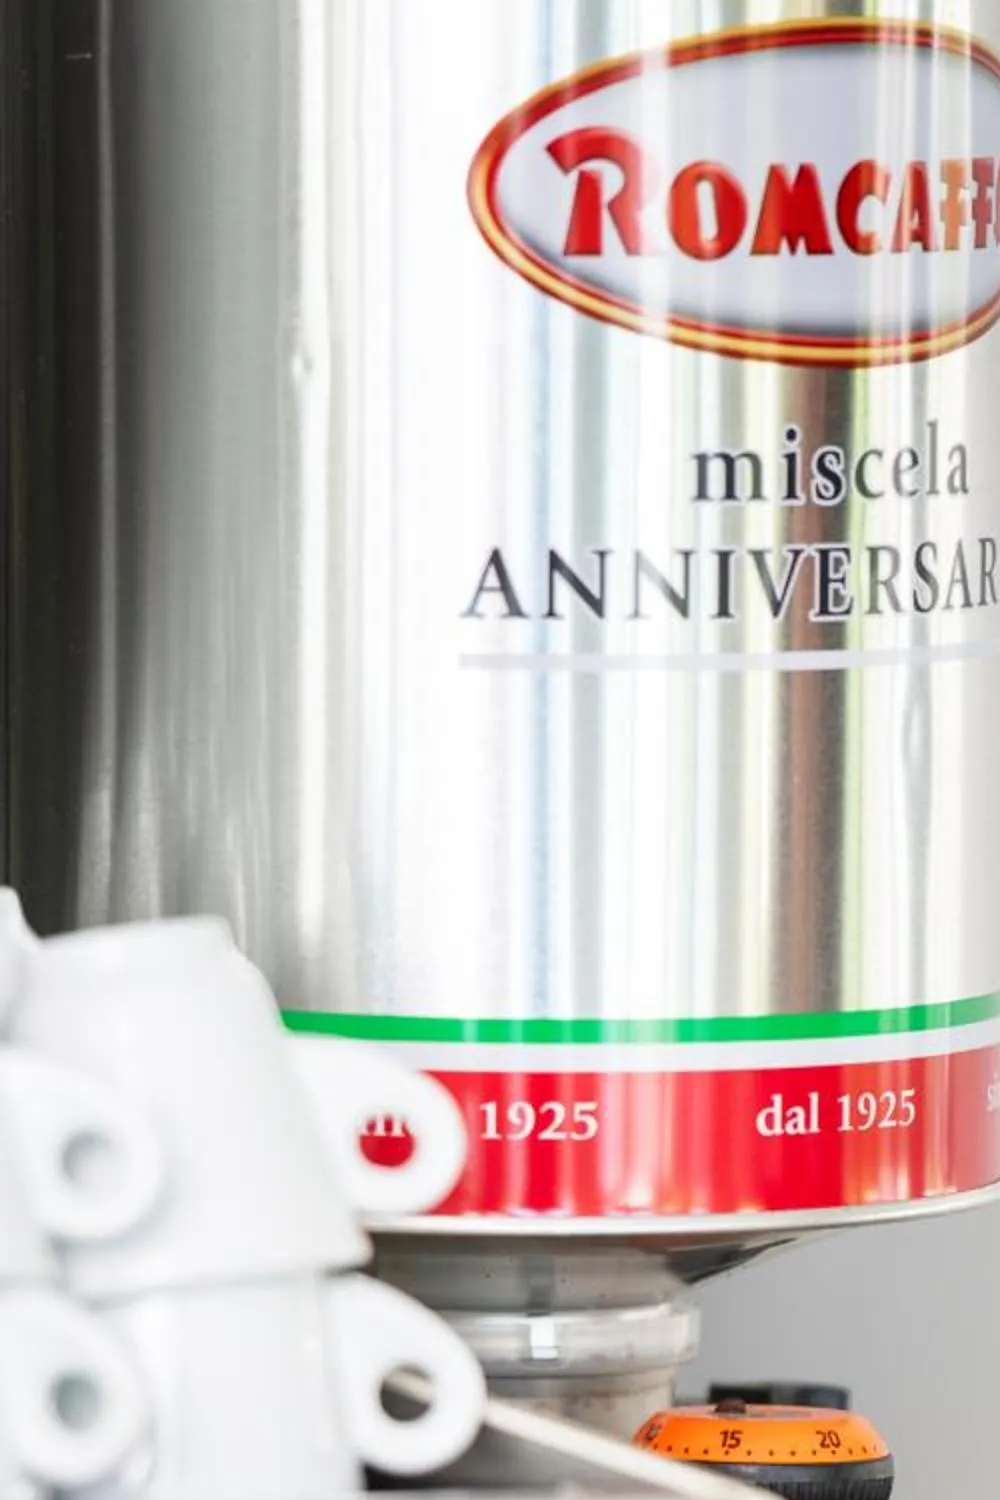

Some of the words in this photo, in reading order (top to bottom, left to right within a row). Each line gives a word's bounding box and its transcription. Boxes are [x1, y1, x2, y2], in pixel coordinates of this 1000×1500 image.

[689, 421, 970, 505] miscela
[479, 1100, 600, 1140] 1925
[755, 1091, 821, 1137] dal
[837, 1088, 917, 1132] 1925
[718, 1429, 745, 1450] 15
[815, 1430, 842, 1449] 20
